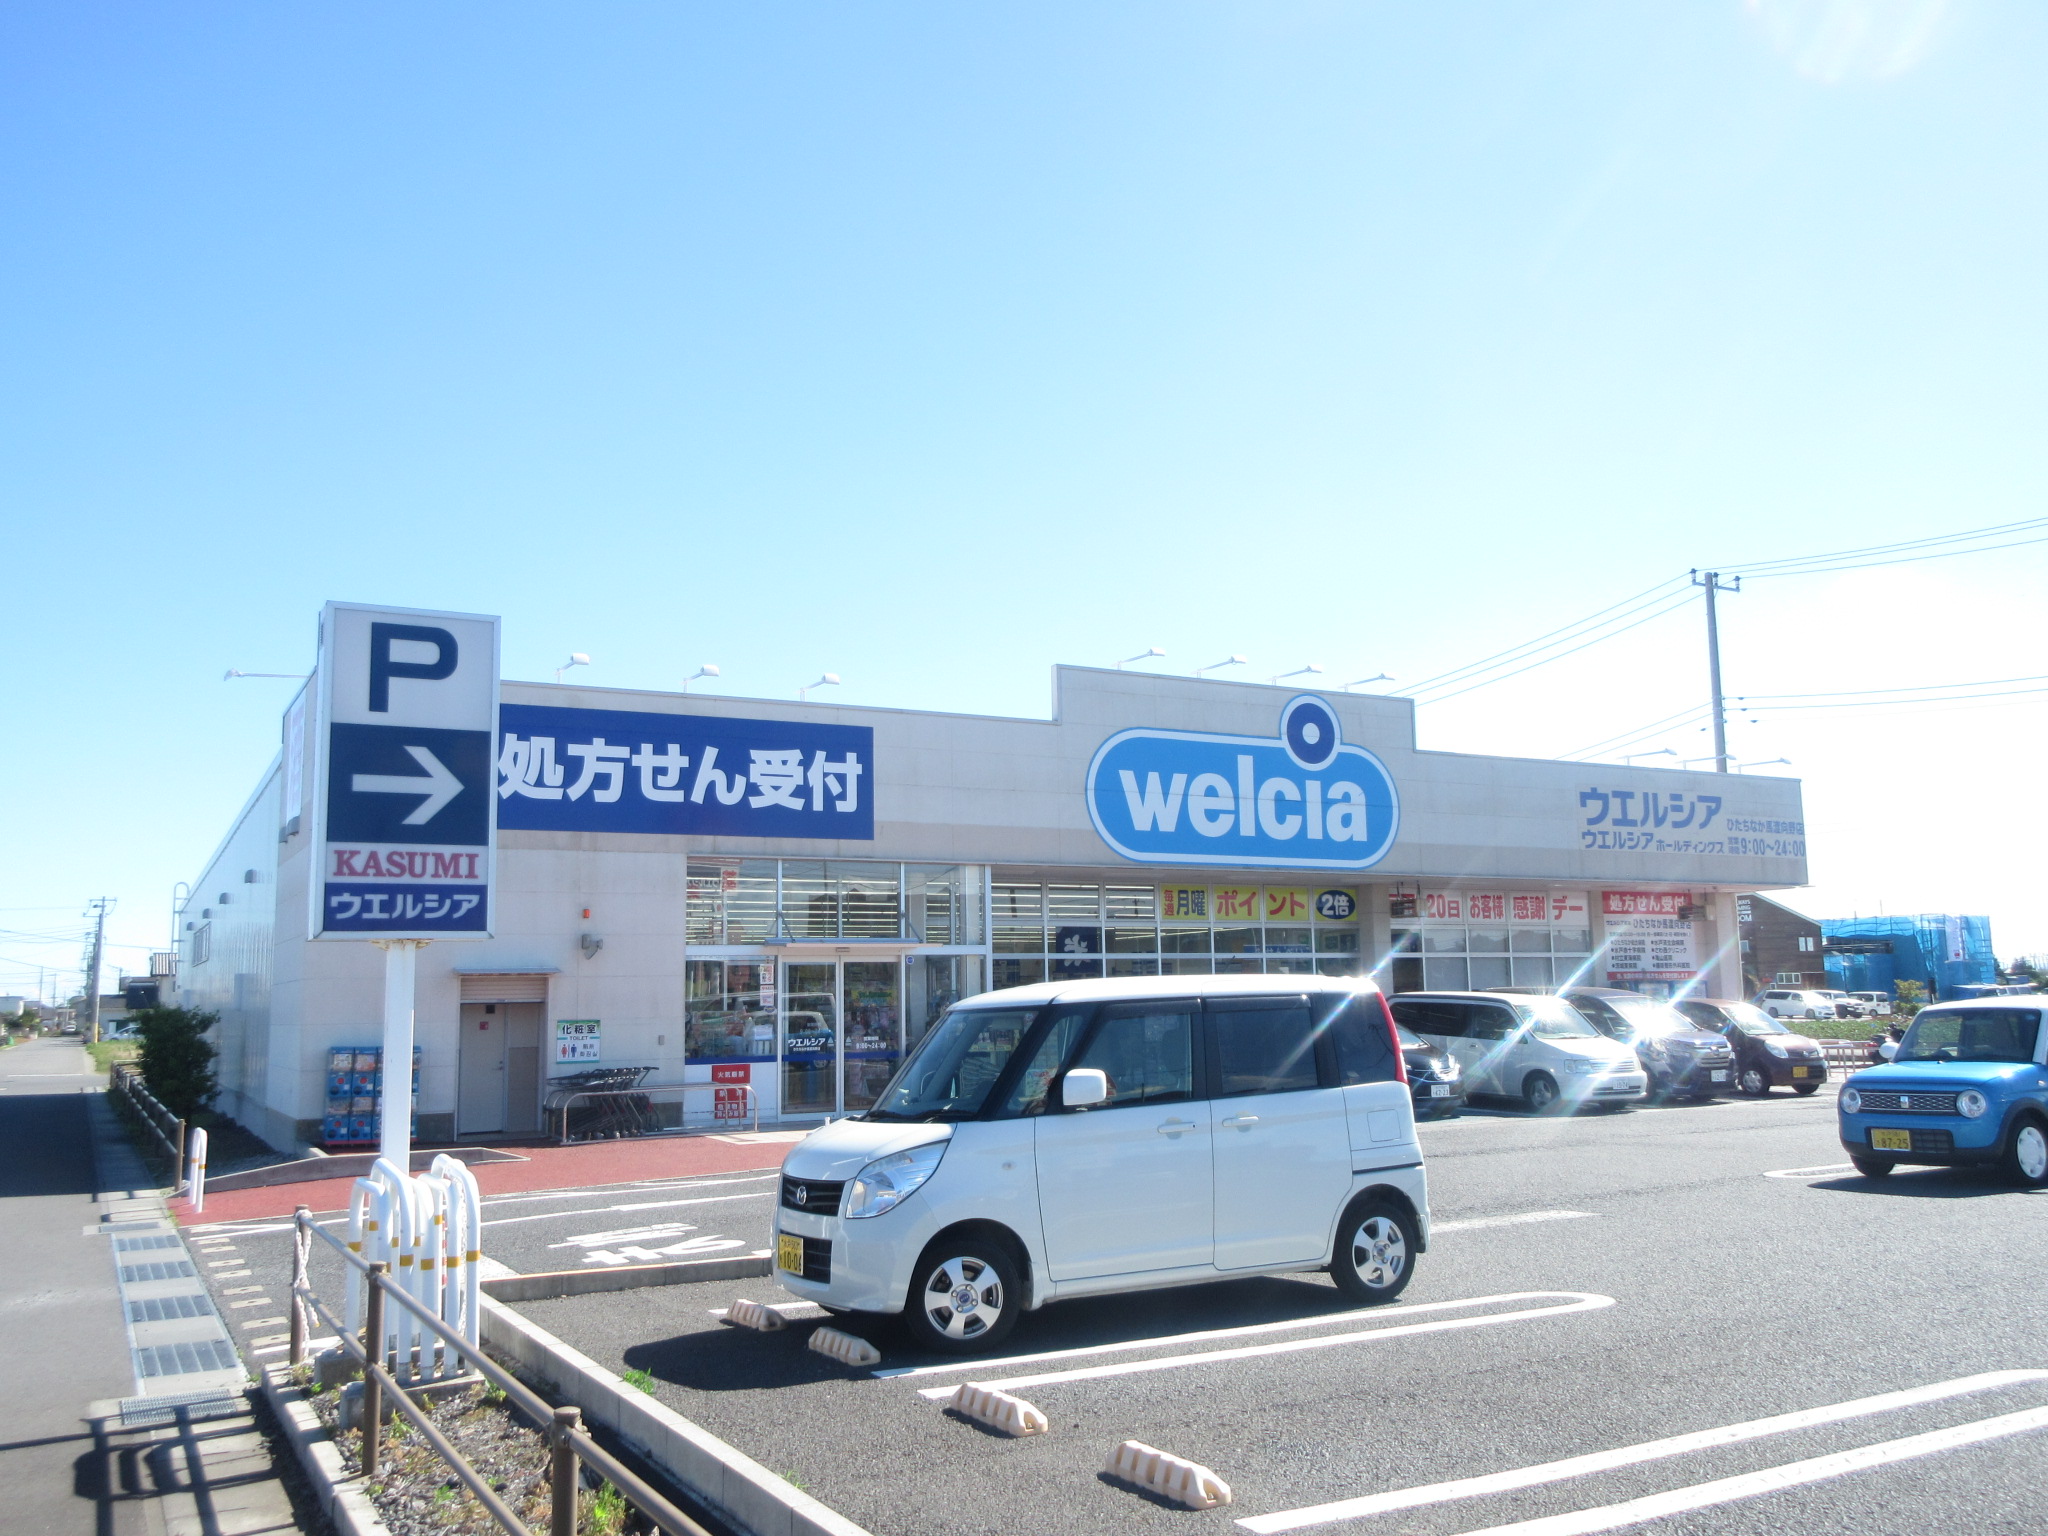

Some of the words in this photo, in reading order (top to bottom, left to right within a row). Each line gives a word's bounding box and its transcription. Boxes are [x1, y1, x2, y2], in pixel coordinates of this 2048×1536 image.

[369, 622, 458, 712] P
[498, 733, 862, 812] 処方せん受付
[1118, 703, 1368, 842] welcia
[1579, 787, 1722, 830] ウエルシア
[1581, 829, 1654, 850] ウエルシア
[1655, 838, 1725, 854] ホールディングス
[333, 850, 479, 879] KASUMI
[330, 892, 480, 919] ウエルシア
[1177, 889, 1206, 916] 月曜
[1216, 889, 1306, 917] ポイント
[1321, 893, 1350, 917] 2倍
[562, 1024, 597, 1035] 化粧室
[788, 1037, 826, 1047] ウエルシア
